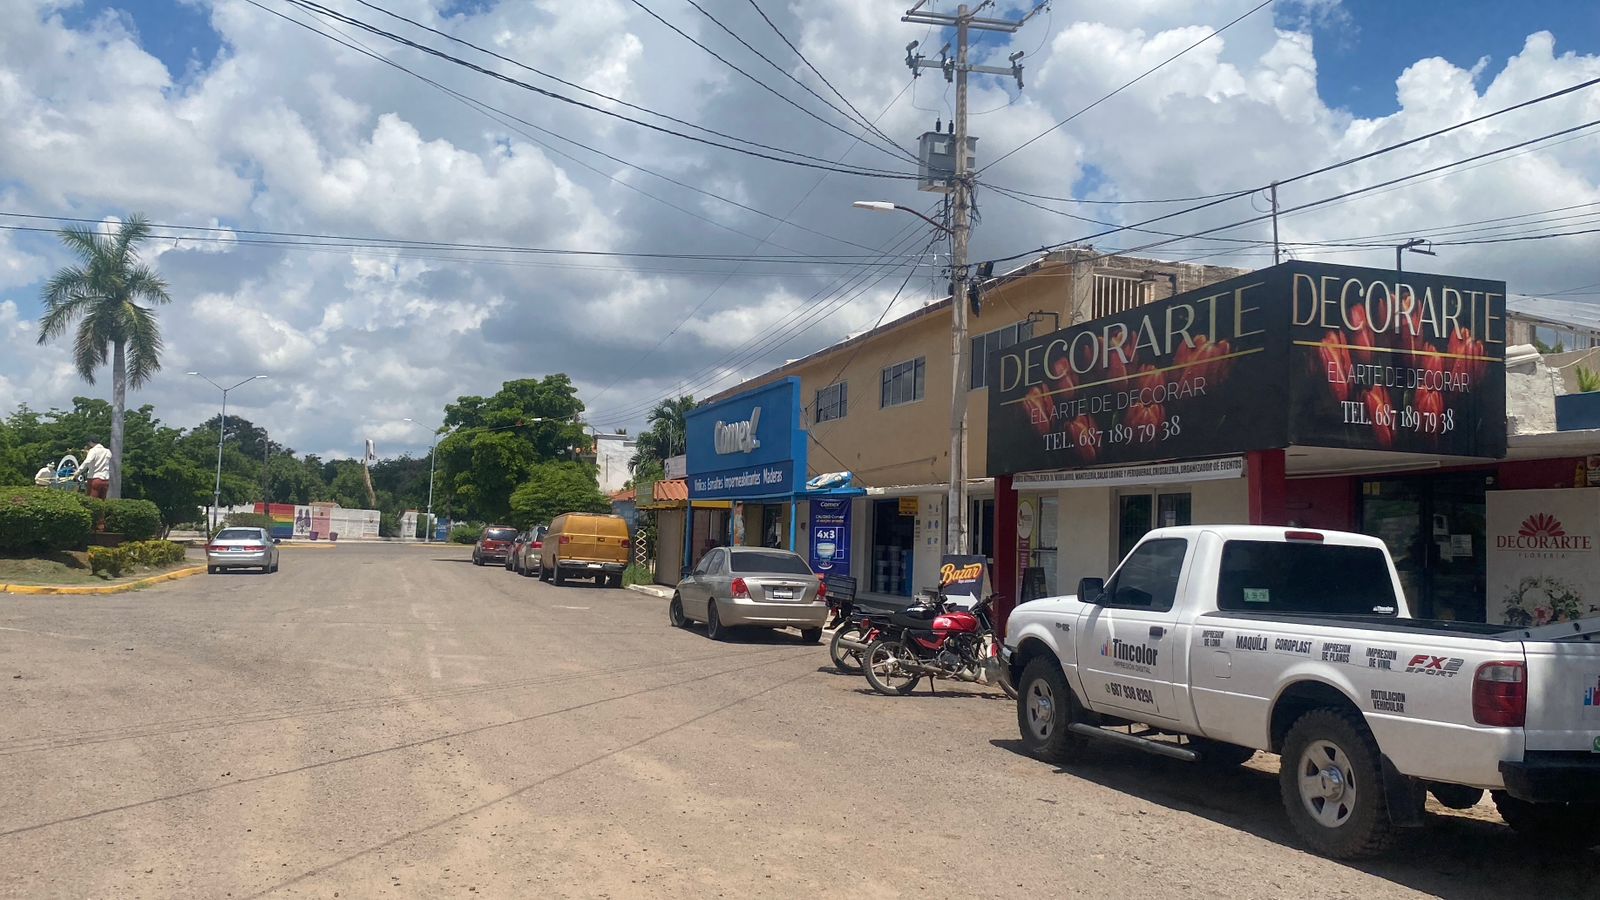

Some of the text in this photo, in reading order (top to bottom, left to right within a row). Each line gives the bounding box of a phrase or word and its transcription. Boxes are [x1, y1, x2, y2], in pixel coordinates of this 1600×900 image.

[1292, 273, 1503, 343] DECORARTE
[1000, 281, 1265, 392] DECORARTE
[1327, 361, 1470, 393] EL ARTE DE DECORAR
[1031, 376, 1207, 424] EL ARTE DE DECORAR
[1340, 400, 1454, 434] TEL. 687 189 79 38
[1043, 415, 1181, 451] TEL. 687 189 79 38
[1213, 462, 1220, 471] DE
[1221, 459, 1242, 470] EVENTOS
[763, 467, 783, 484] Maderas
[817, 529, 836, 539] 4x3
[1496, 535, 1592, 550] DECORARTE
[940, 562, 982, 587] Bazar
[1113, 638, 1158, 666] Tincolor
[1275, 638, 1312, 654] COROPLAST
[1322, 642, 1351, 653] IMPRESION
[1366, 647, 1397, 660] IMPRESION
[1322, 651, 1328, 661] DE
[1369, 657, 1376, 667] DE
[1408, 654, 1464, 671] FX2
[1405, 666, 1458, 678] SPORT
[1110, 682, 1123, 698] 687
[1371, 689, 1406, 703] ROTULACION
[1373, 700, 1405, 713] VEHICULAR
